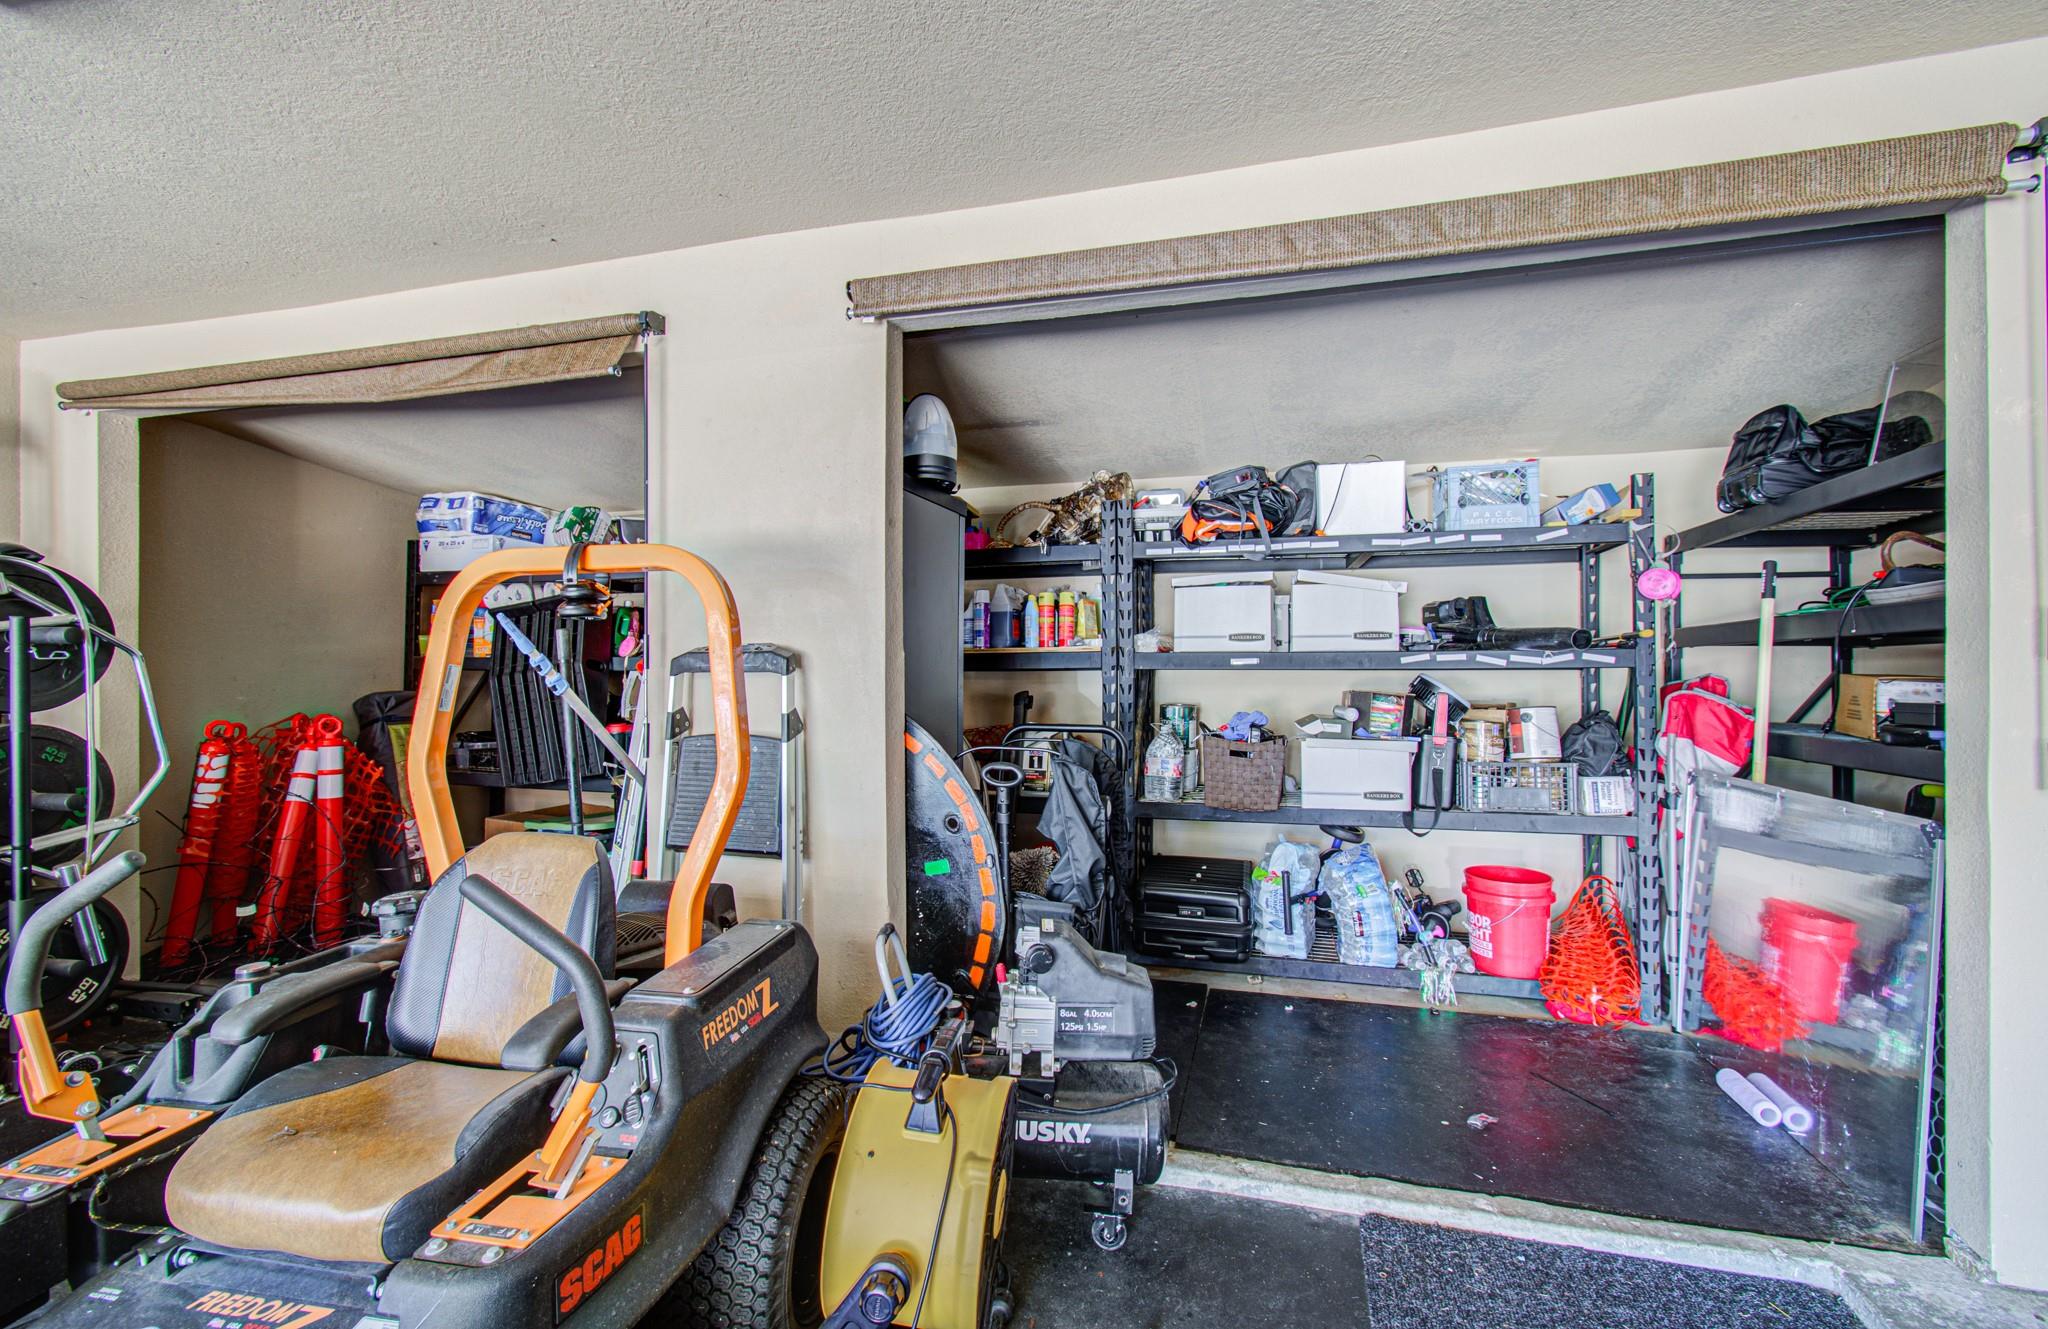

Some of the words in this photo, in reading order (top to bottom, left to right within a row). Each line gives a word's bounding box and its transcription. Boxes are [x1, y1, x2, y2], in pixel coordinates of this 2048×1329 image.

[525, 517, 547, 535] Bath
[41, 746, 58, 762] 25
[67, 988, 88, 1004] 45
[78, 977, 99, 994] LB
[702, 989, 760, 1051] FREEDOM
[754, 976, 780, 1018] Z
[1015, 1119, 1091, 1144] USKY
[560, 1215, 641, 1313] SCAG
[185, 1290, 304, 1323] FREEDOM
